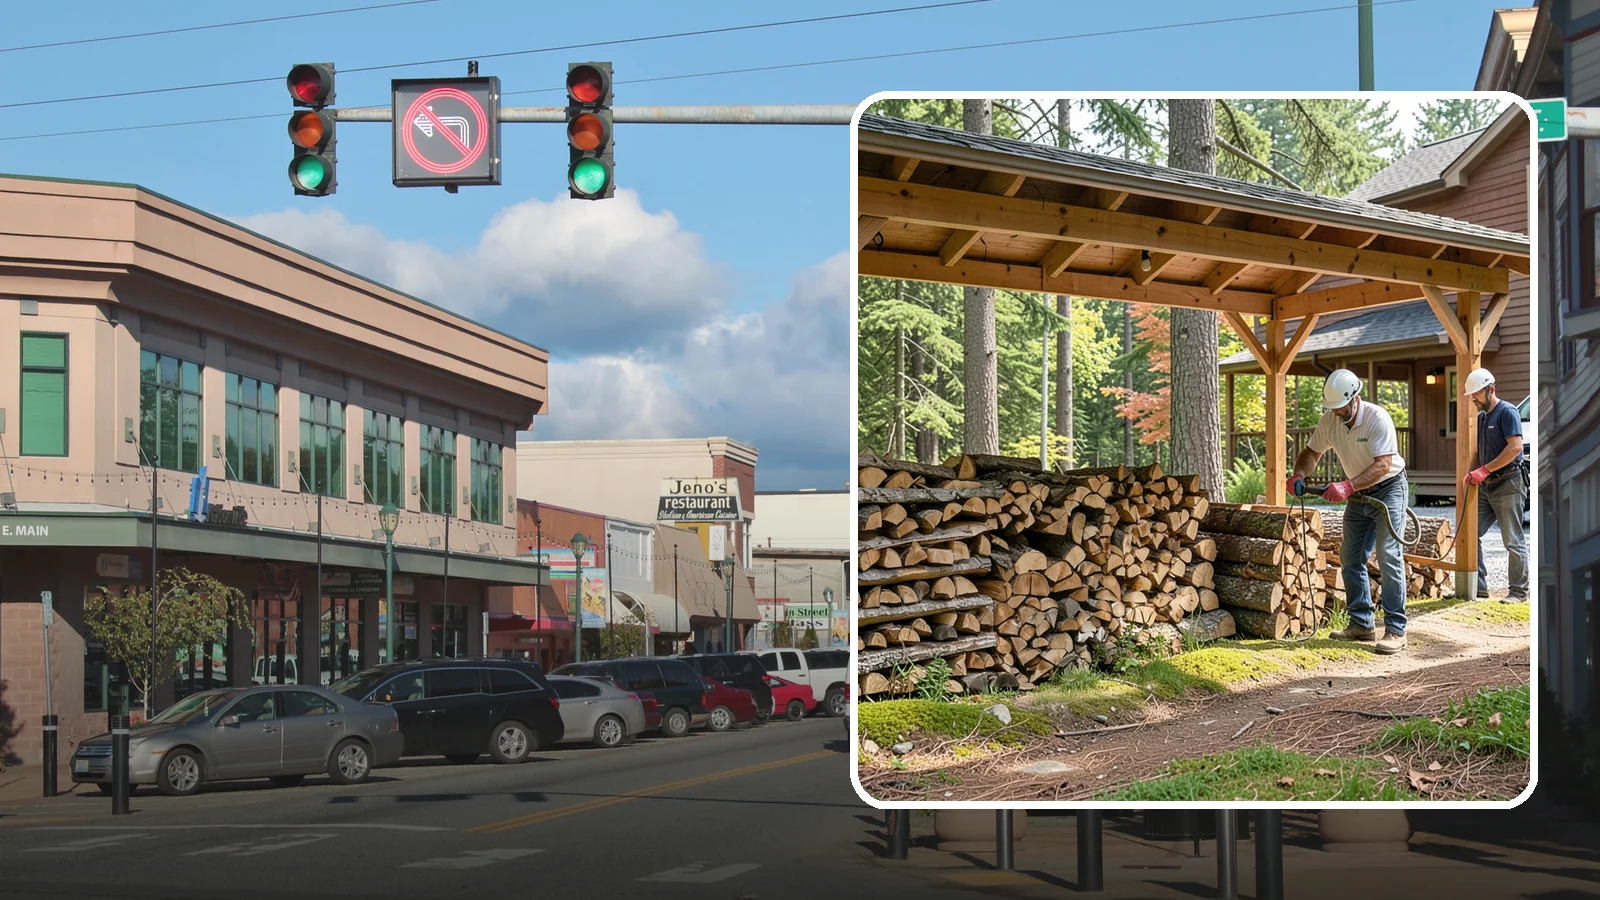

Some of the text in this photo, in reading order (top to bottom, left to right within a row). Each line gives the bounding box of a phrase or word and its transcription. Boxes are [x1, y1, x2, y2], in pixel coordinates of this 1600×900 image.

[669, 480, 727, 494] Jeno's
[665, 497, 731, 509] restaurant
[658, 510, 681, 519] Italian
[686, 510, 714, 519] American
[715, 510, 738, 519] Cuisine
[2, 525, 49, 536] E. MAIN
[797, 607, 829, 616] Street
[790, 619, 823, 627] lass
